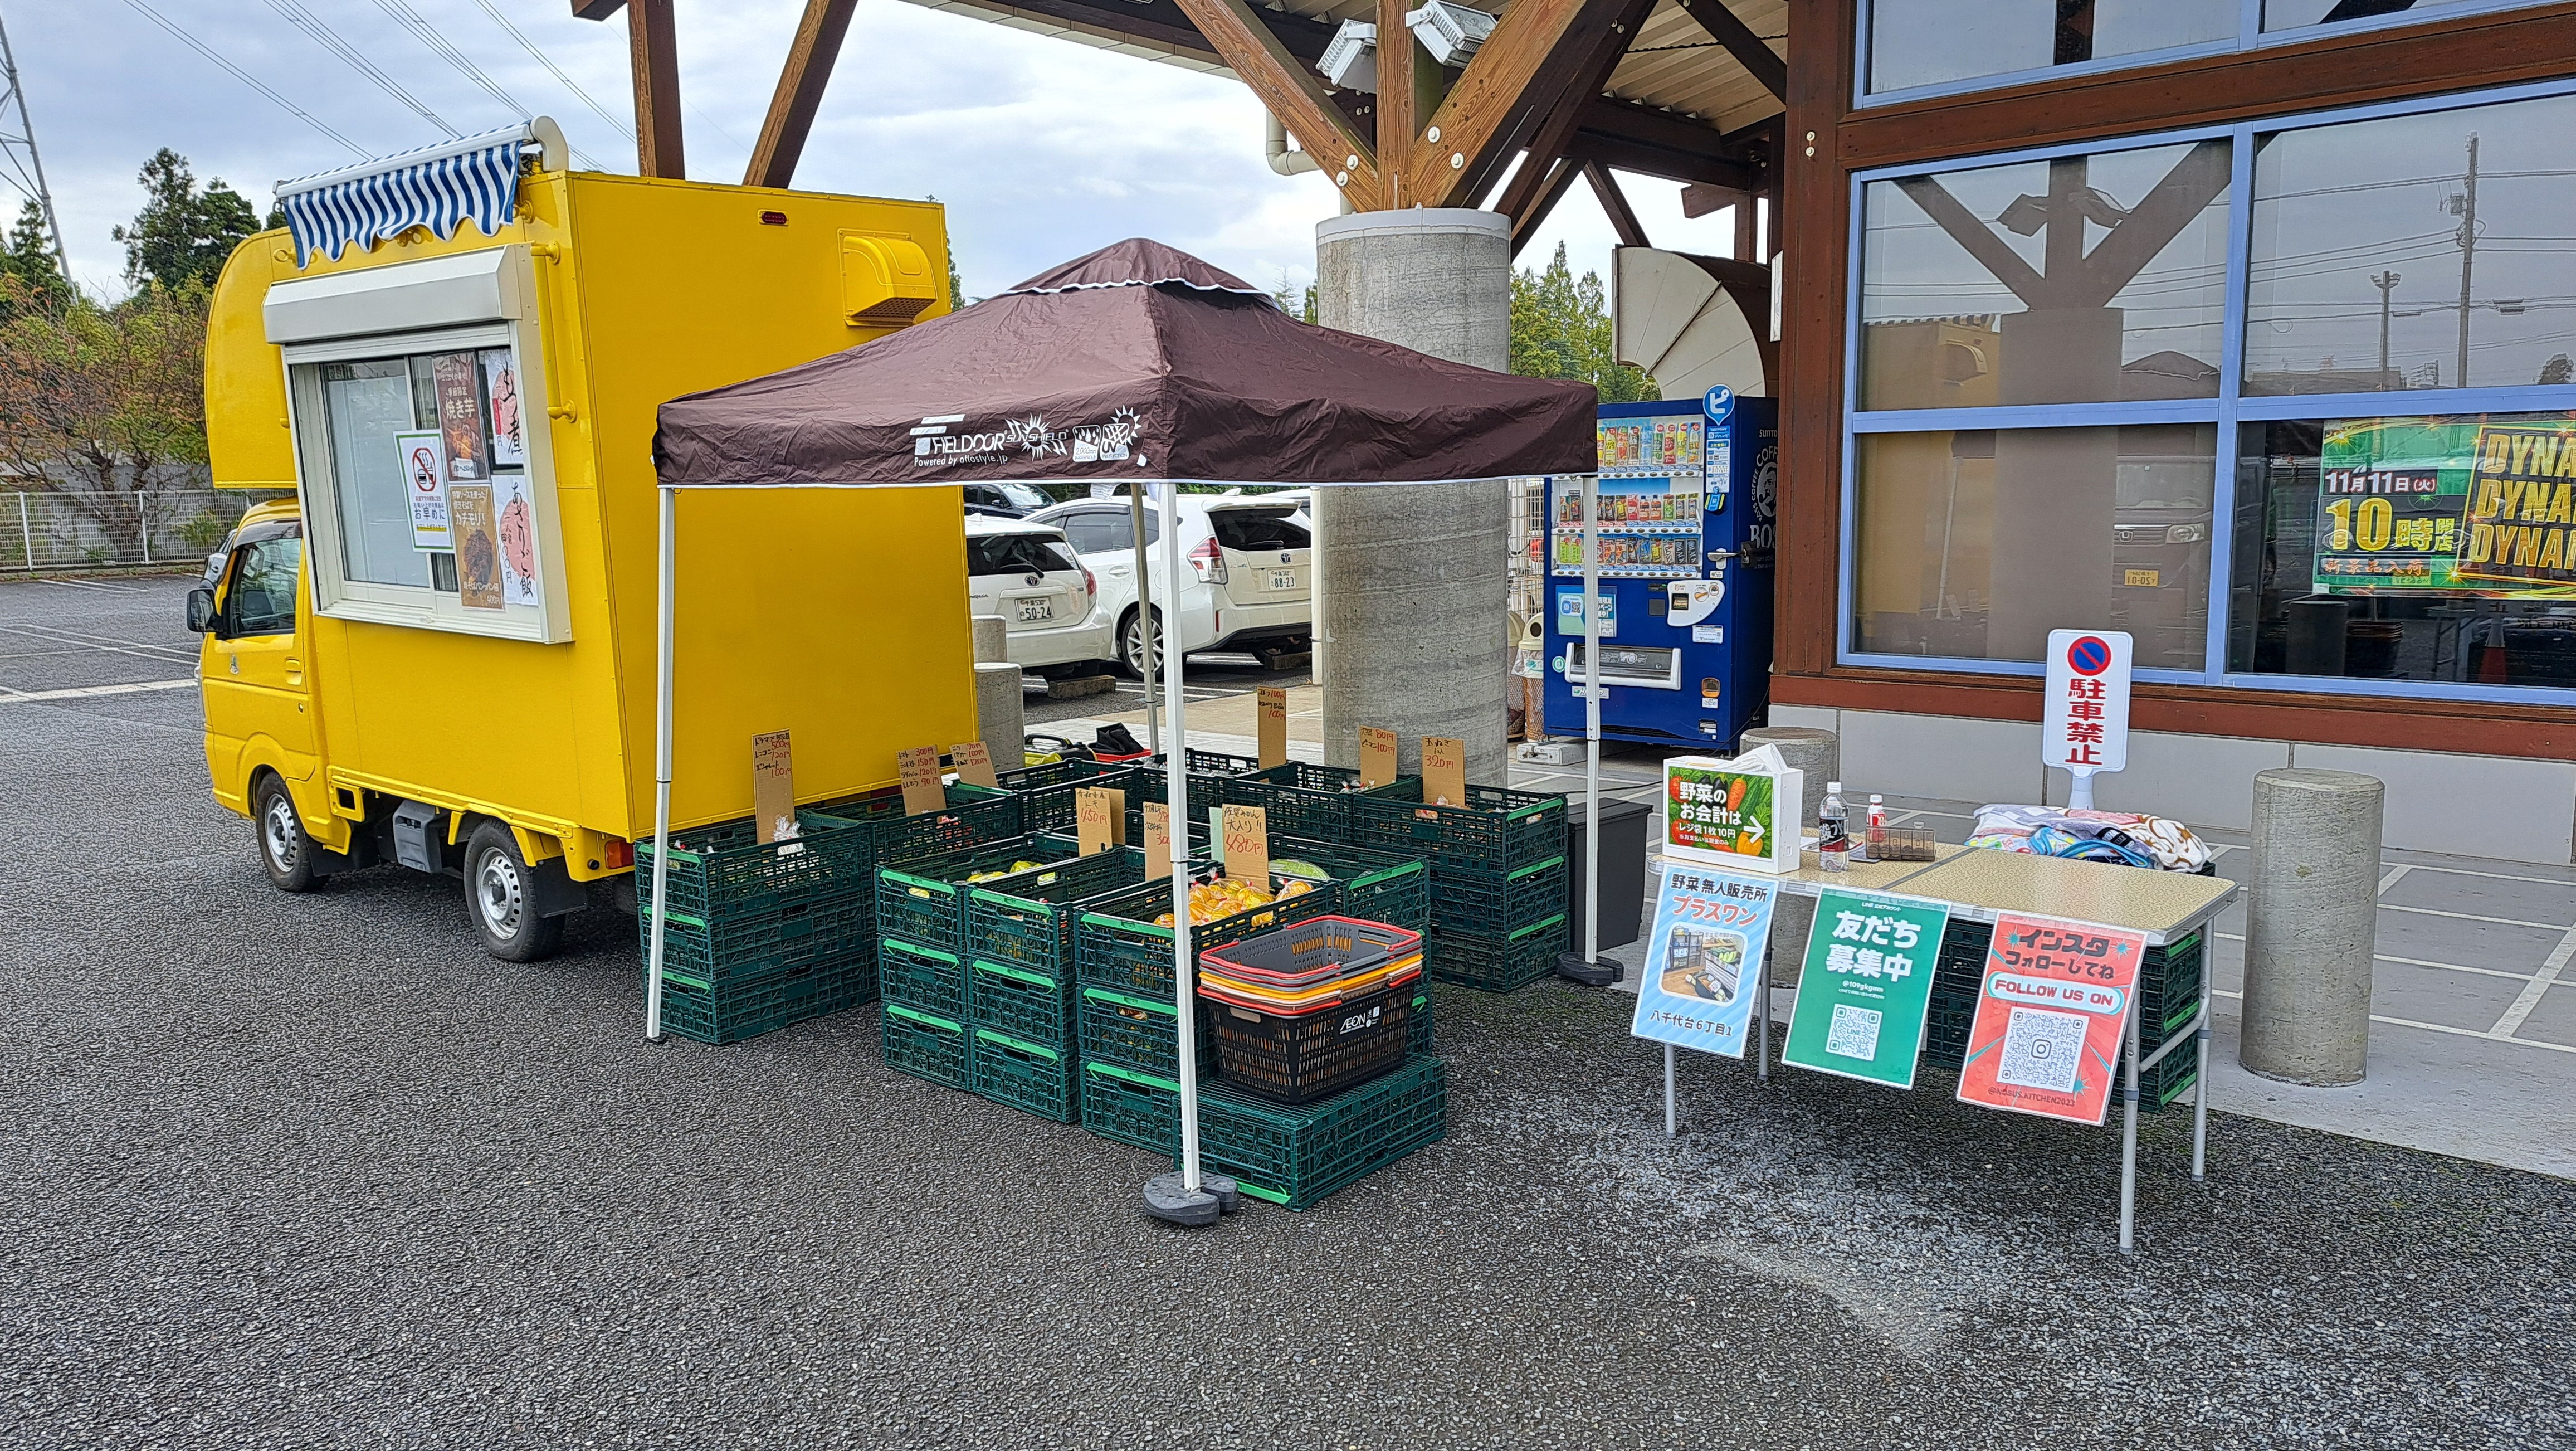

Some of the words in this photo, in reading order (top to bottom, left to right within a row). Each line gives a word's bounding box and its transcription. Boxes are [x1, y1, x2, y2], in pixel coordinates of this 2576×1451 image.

[446, 397, 475, 420] 焼き芋
[1710, 389, 1730, 414] ピ
[932, 432, 1005, 454] FIELDOOR
[914, 455, 946, 467] Powered
[948, 455, 958, 467] by
[2475, 479, 2576, 524] DYNA
[414, 508, 446, 520] お早めに
[1274, 577, 1295, 588] 88-23
[1025, 606, 1052, 620] 50-24
[2065, 678, 2107, 766] 駐車禁止
[1375, 729, 1394, 742] 80円
[1424, 737, 1452, 747] 玉ねぎ
[915, 747, 934, 757] 300円
[968, 749, 985, 758] 100円
[1377, 742, 1396, 757] 100円
[917, 757, 935, 767] 150円
[1424, 754, 1454, 770] 320円
[919, 767, 937, 777] 120円
[921, 777, 940, 787] 90円
[1679, 782, 1728, 804] 野菜の
[1080, 807, 1108, 826] 450円
[1224, 806, 1262, 819] 佐賀みかん
[1679, 804, 1743, 826] お会計は
[1679, 822, 1736, 839] レジ袋1枚10円
[1226, 834, 1263, 856] 480円
[1672, 895, 1759, 926] プラスワン
[1832, 910, 1922, 949] 友だち
[2019, 929, 2111, 957] インスタ
[1825, 943, 1914, 982] 募集中
[2004, 950, 2115, 980] フォローしてね
[1842, 980, 1884, 992] @109gkgam
[1994, 979, 2058, 999] FOLLOW
[2062, 987, 2085, 1002] US
[2089, 992, 2114, 1006] ON
[1650, 1009, 1733, 1038] 八千代台6丁目1
